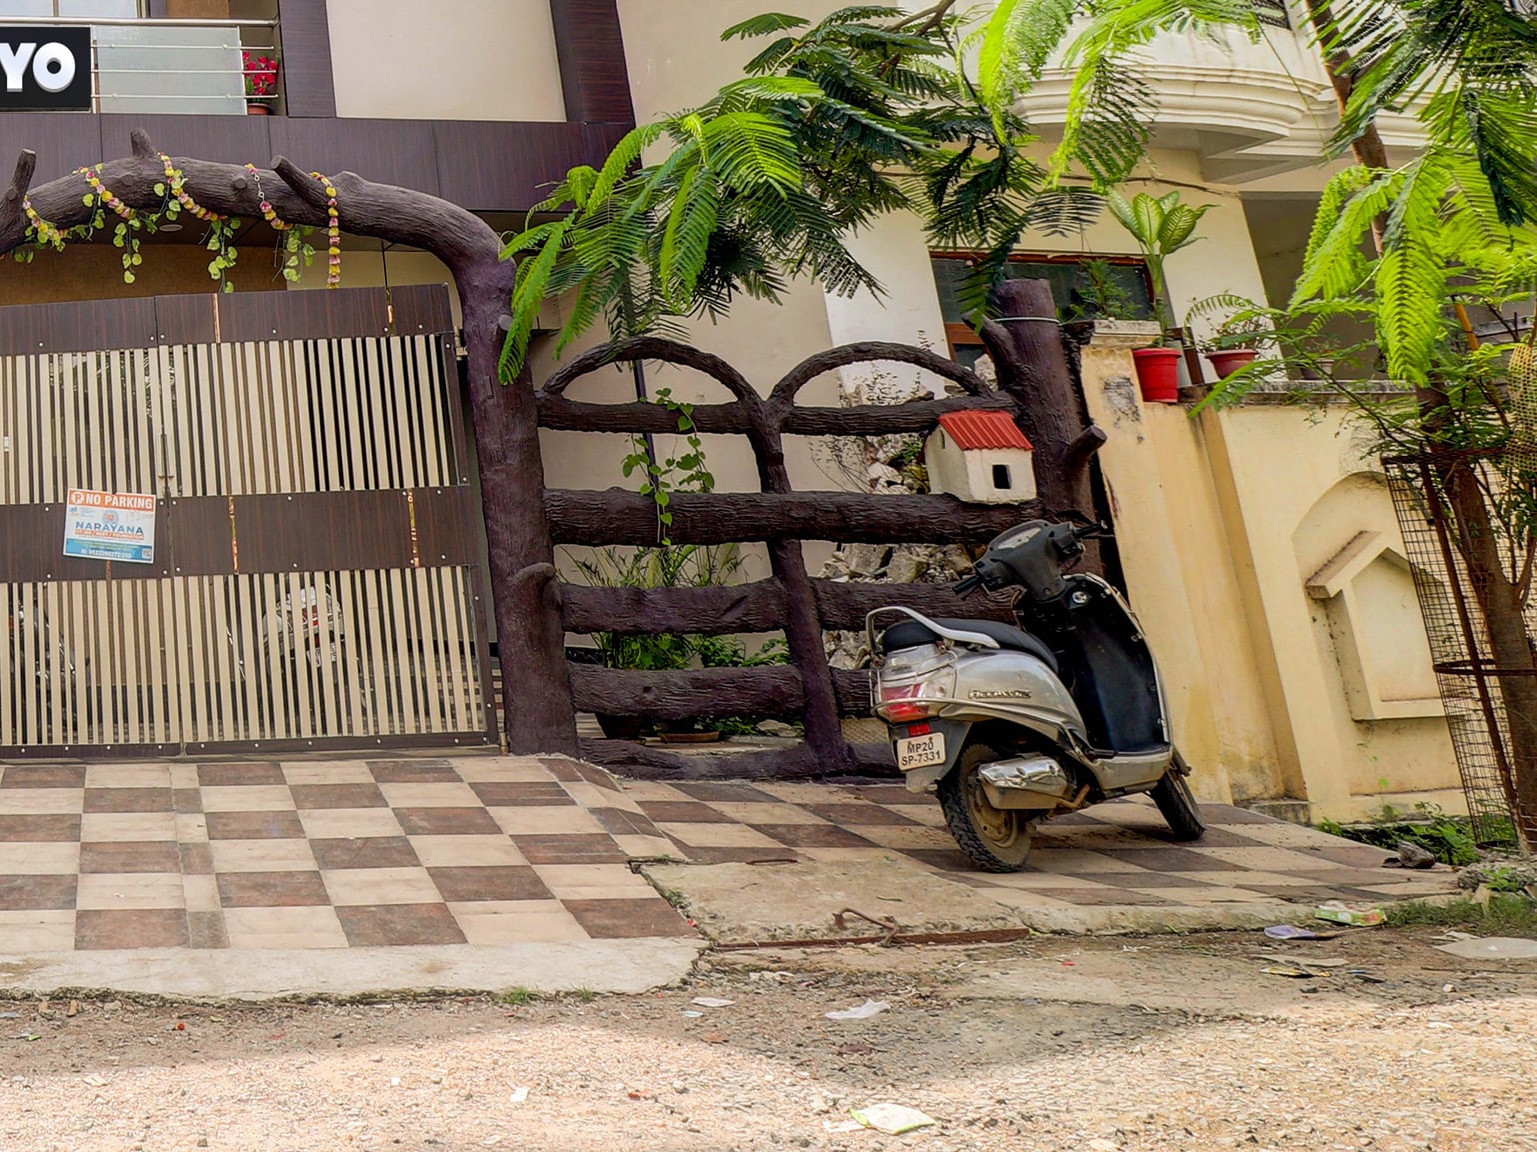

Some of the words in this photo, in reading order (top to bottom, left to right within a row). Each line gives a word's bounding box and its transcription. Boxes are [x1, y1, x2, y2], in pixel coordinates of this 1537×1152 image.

[85, 493, 101, 506] NO
[104, 495, 153, 510] PARKING
[75, 521, 144, 535] NARAYANA
[907, 741, 934, 754] MP20
[901, 750, 941, 766] SP-7331
